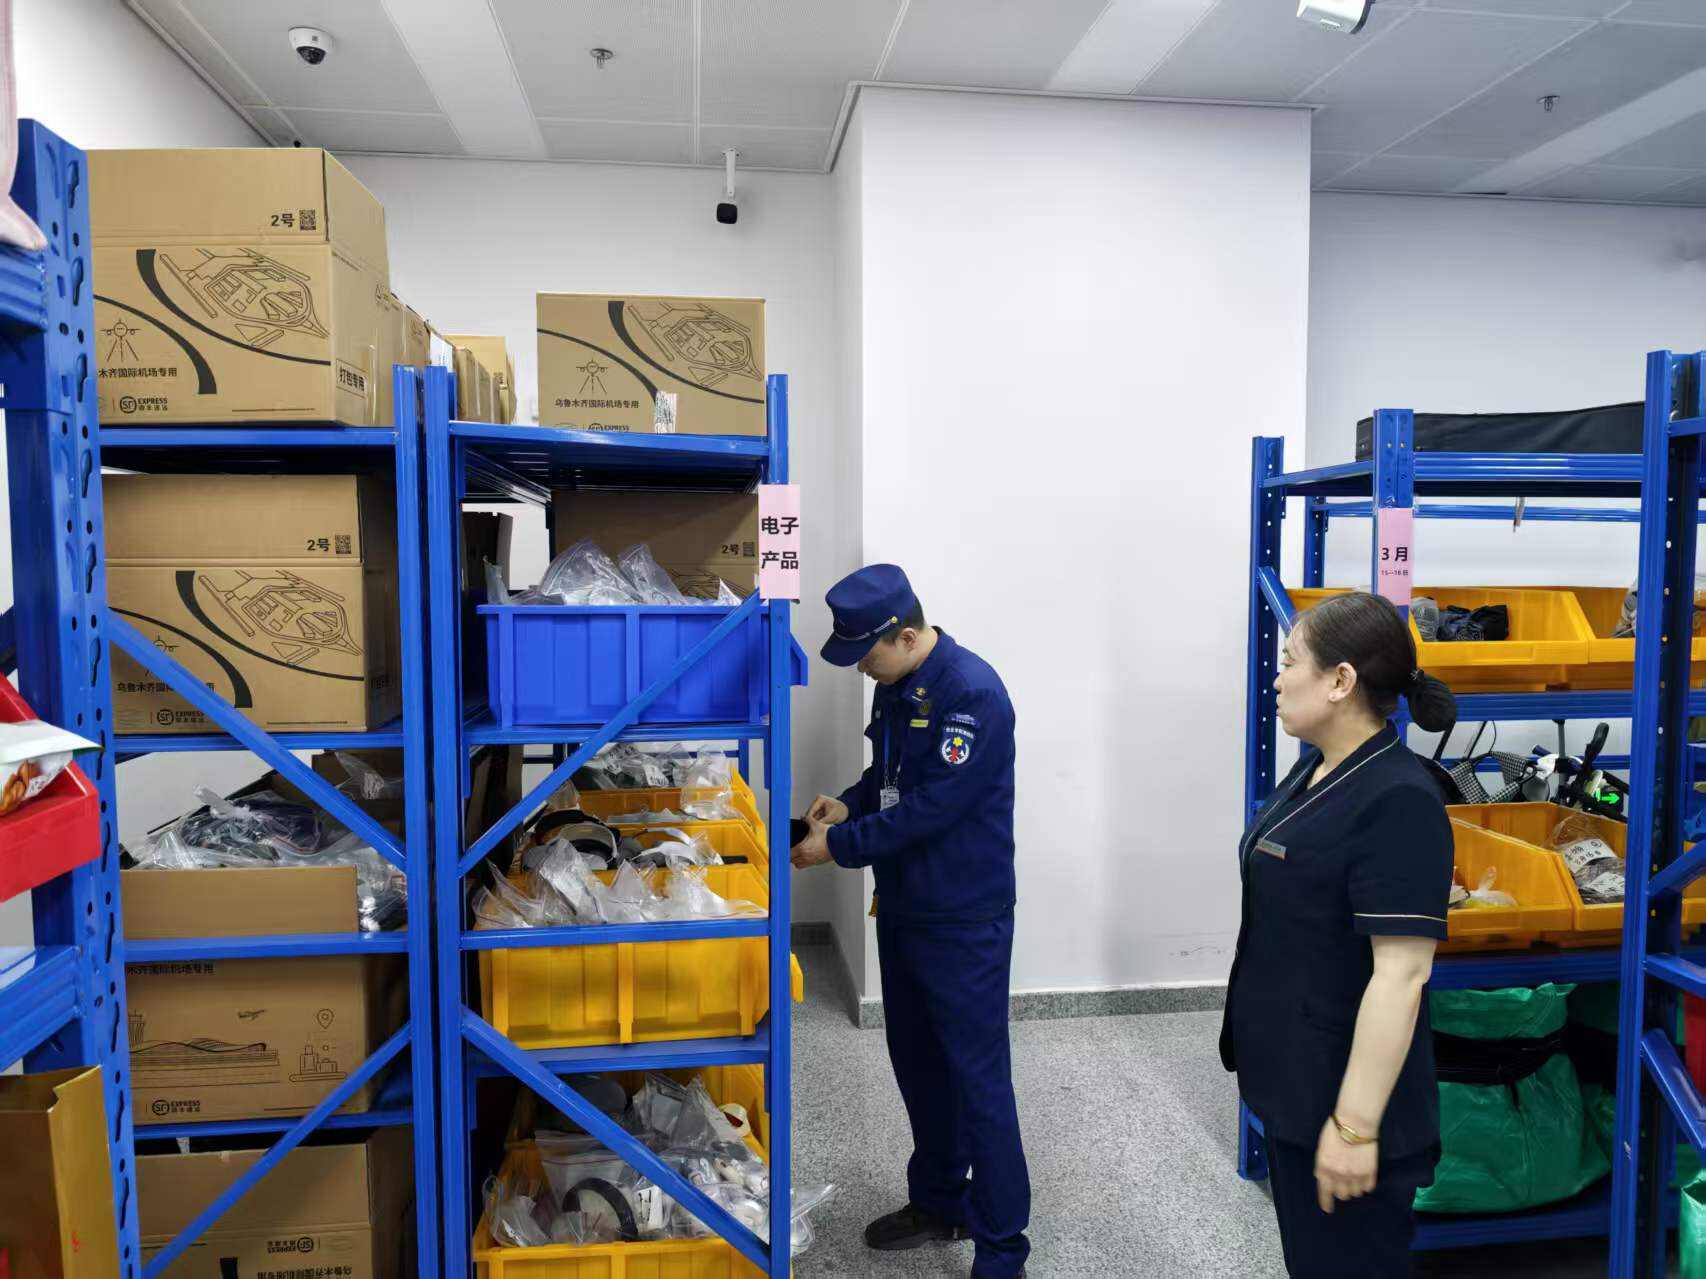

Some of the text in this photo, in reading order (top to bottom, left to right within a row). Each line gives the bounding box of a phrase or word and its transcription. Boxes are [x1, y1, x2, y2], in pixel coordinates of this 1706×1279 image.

[271, 213, 295, 227] 2号
[555, 398, 640, 409] 乌鲁木齐国际机场专用
[761, 516, 799, 535] 电子
[307, 538, 331, 551] 2号
[721, 543, 739, 556] 2号
[761, 551, 799, 570] 产品
